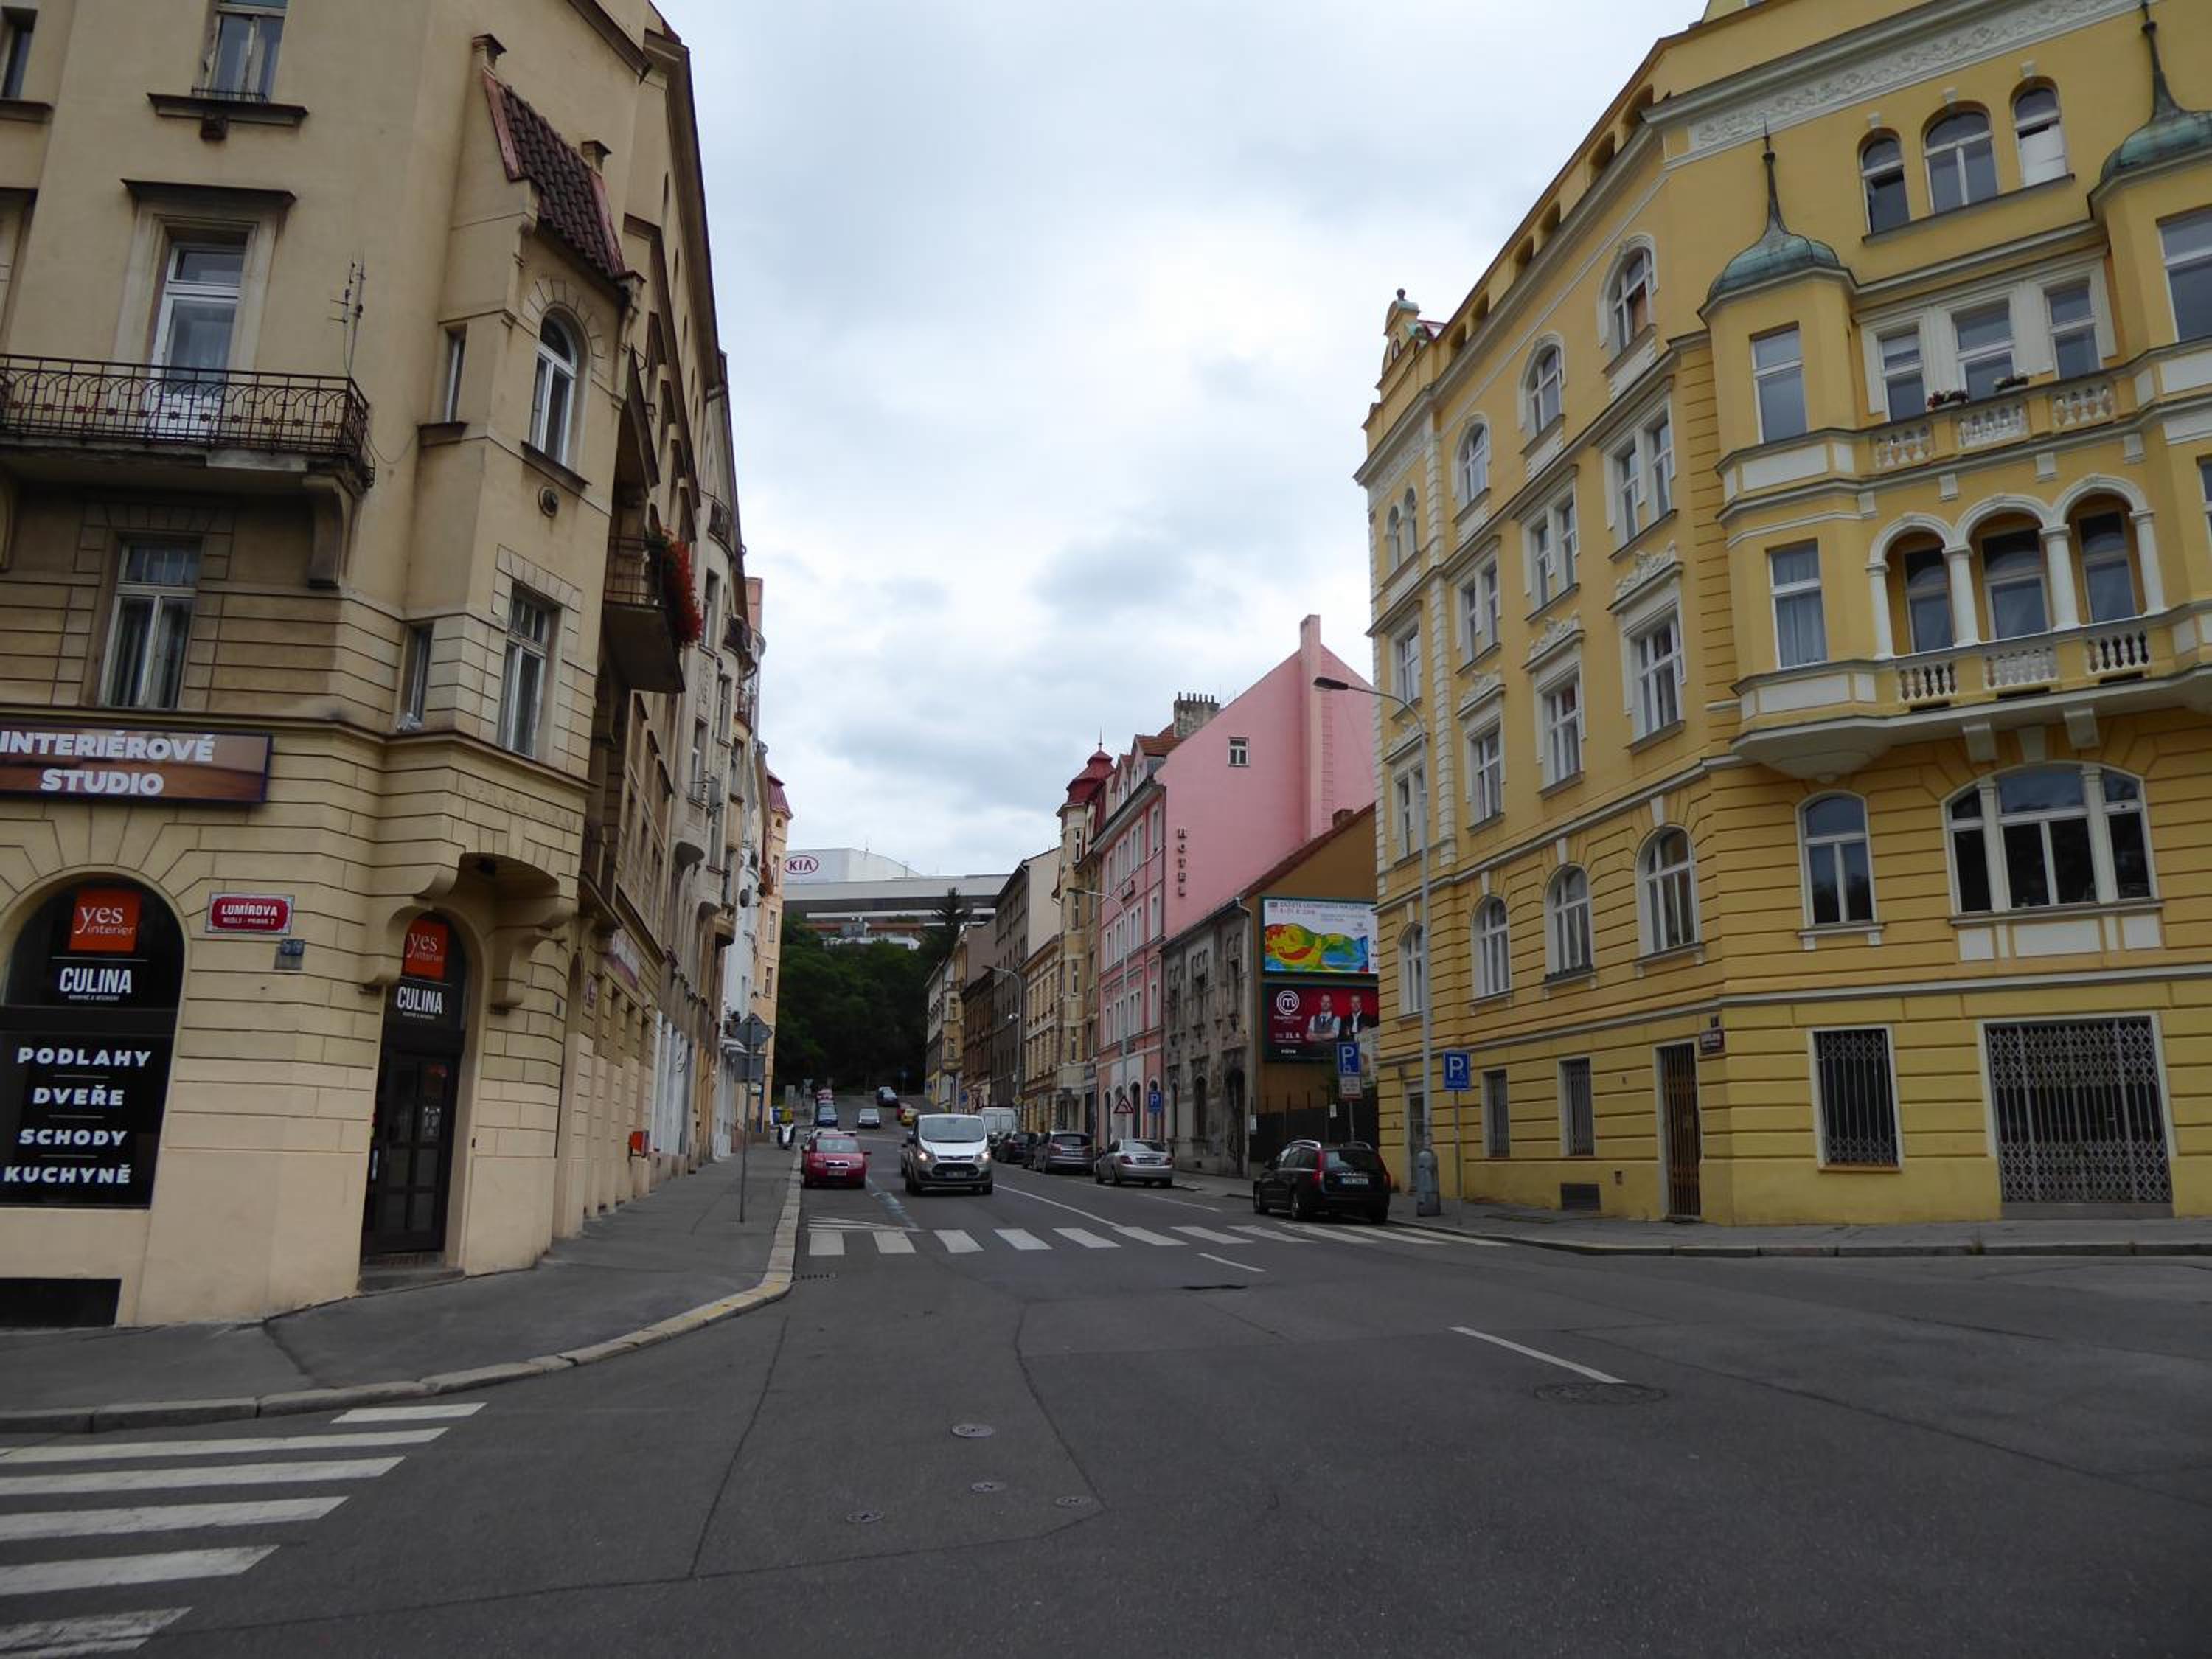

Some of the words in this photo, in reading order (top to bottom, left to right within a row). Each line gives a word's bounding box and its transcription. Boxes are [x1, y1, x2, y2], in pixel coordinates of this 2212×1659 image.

[0, 729, 215, 762] INTERIÉROVÉ
[40, 768, 164, 795] STUDIO
[790, 860, 812, 870] KIA
[221, 902, 278, 917] LUMÍROVA
[74, 907, 124, 935] yes
[407, 933, 437, 958] yes
[59, 967, 132, 993] CULINA
[397, 986, 442, 1014] CULINA
[17, 1047, 151, 1067] PODLAHY
[1450, 1057, 1464, 1079] P
[33, 1085, 125, 1105] DVEŘE
[18, 1129, 128, 1146] SCHODY
[4, 1164, 131, 1184] KUCHYNĚ
